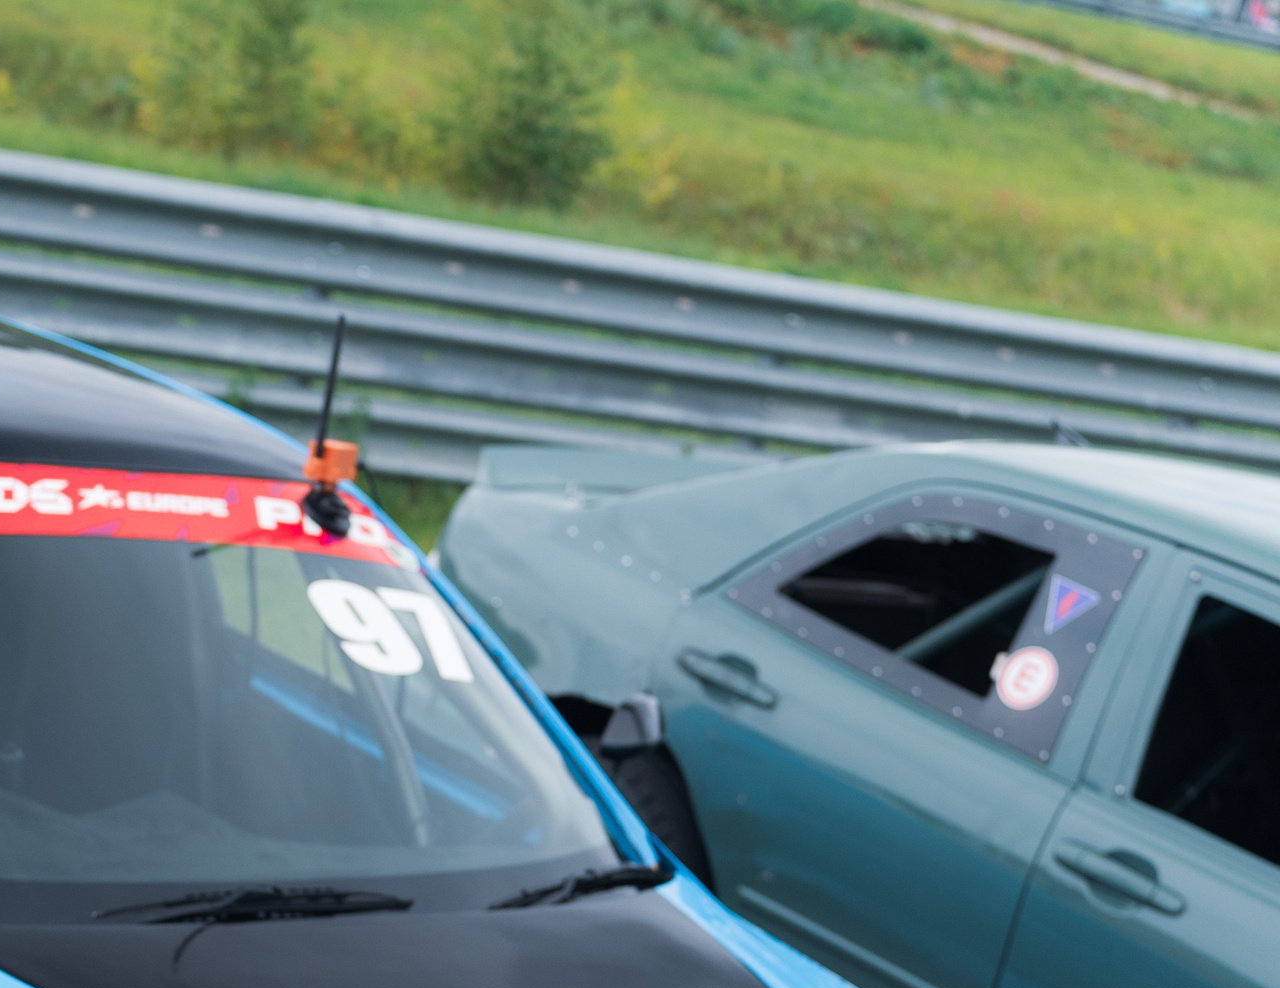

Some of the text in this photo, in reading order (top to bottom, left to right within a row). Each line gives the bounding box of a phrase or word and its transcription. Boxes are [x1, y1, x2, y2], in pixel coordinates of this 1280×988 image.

[126, 490, 230, 518] EUROPE
[254, 495, 389, 548] PO
[306, 578, 475, 683] 97
